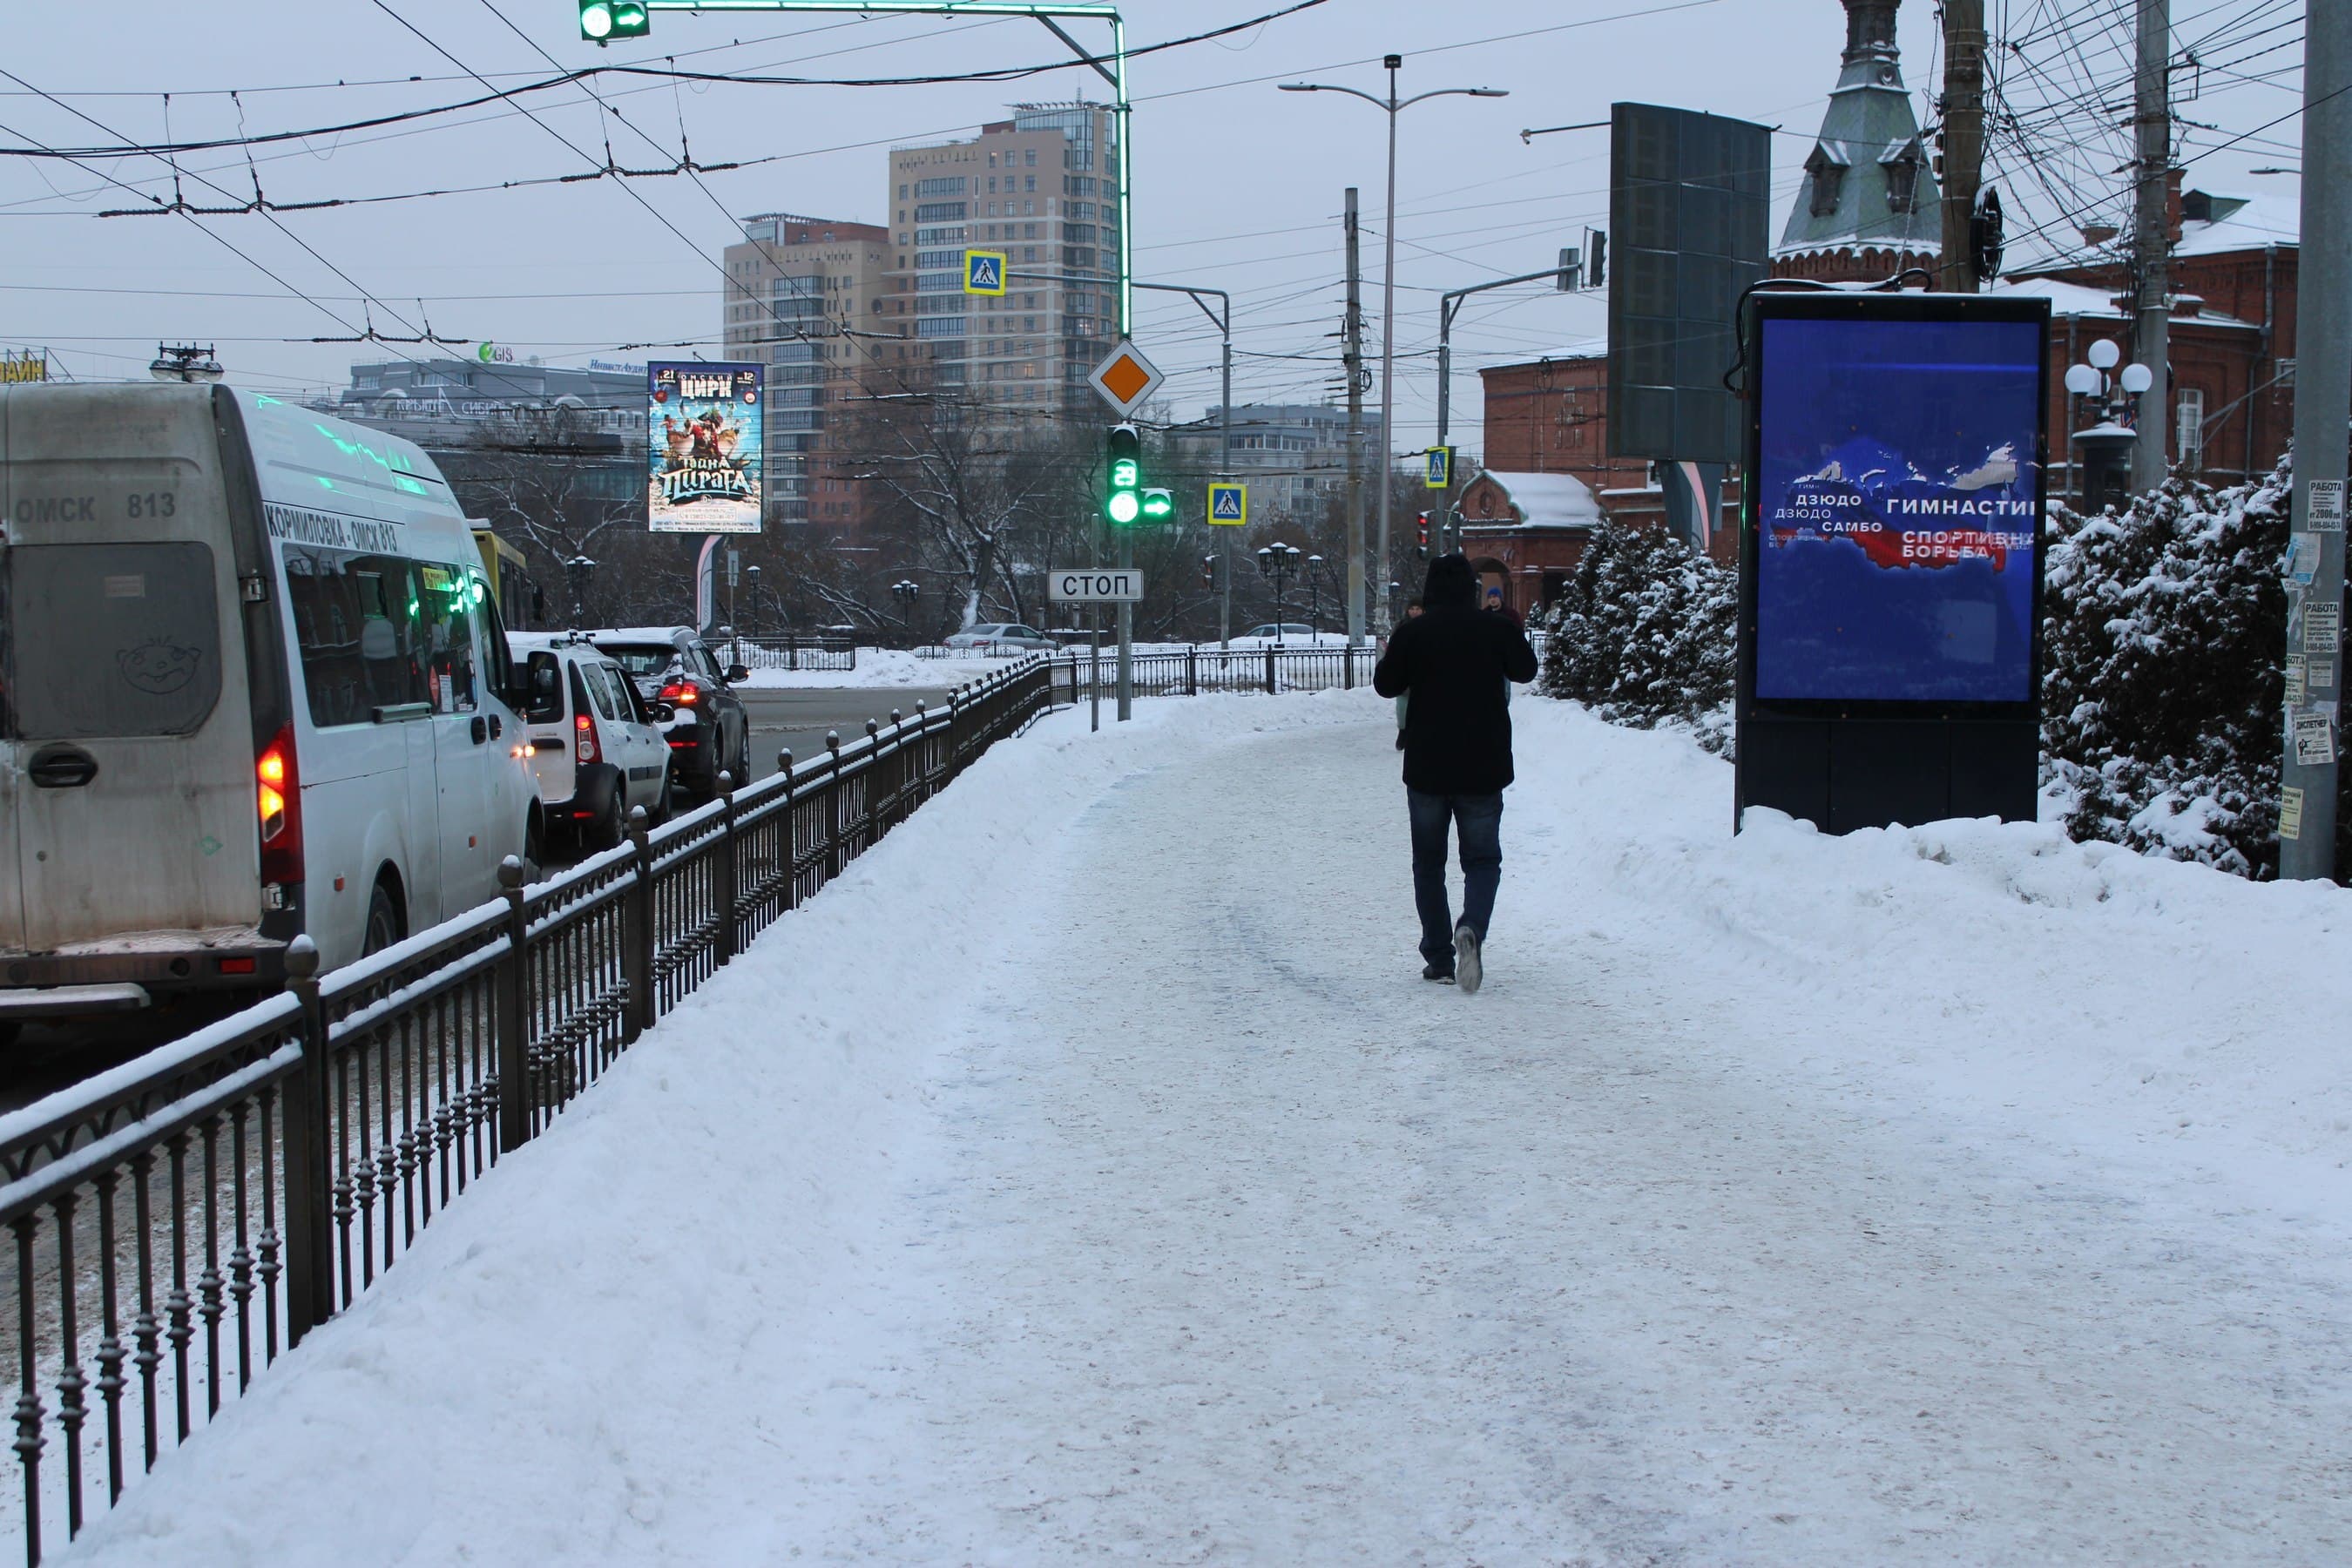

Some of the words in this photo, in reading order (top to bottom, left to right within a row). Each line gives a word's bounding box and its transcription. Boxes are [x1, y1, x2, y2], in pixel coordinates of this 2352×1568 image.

[680, 381, 732, 399] ЦИРК
[2310, 483, 2342, 491] РАБОТА
[1795, 494, 1862, 507] ДЗЮДО
[16, 497, 95, 523] ОМСК
[128, 492, 175, 518] 813
[2316, 510, 2333, 518] 2000
[1774, 509, 1831, 520] ДЗЮДО
[265, 504, 347, 547] КОРМИЛОВКА
[351, 521, 380, 552] ОМСК
[380, 523, 398, 552] 813
[1821, 522, 1882, 533] САМБО
[1902, 545, 1990, 558] БОРЬБА
[1063, 576, 1128, 595] СТОП
[2306, 604, 2338, 612] РАБОТА
